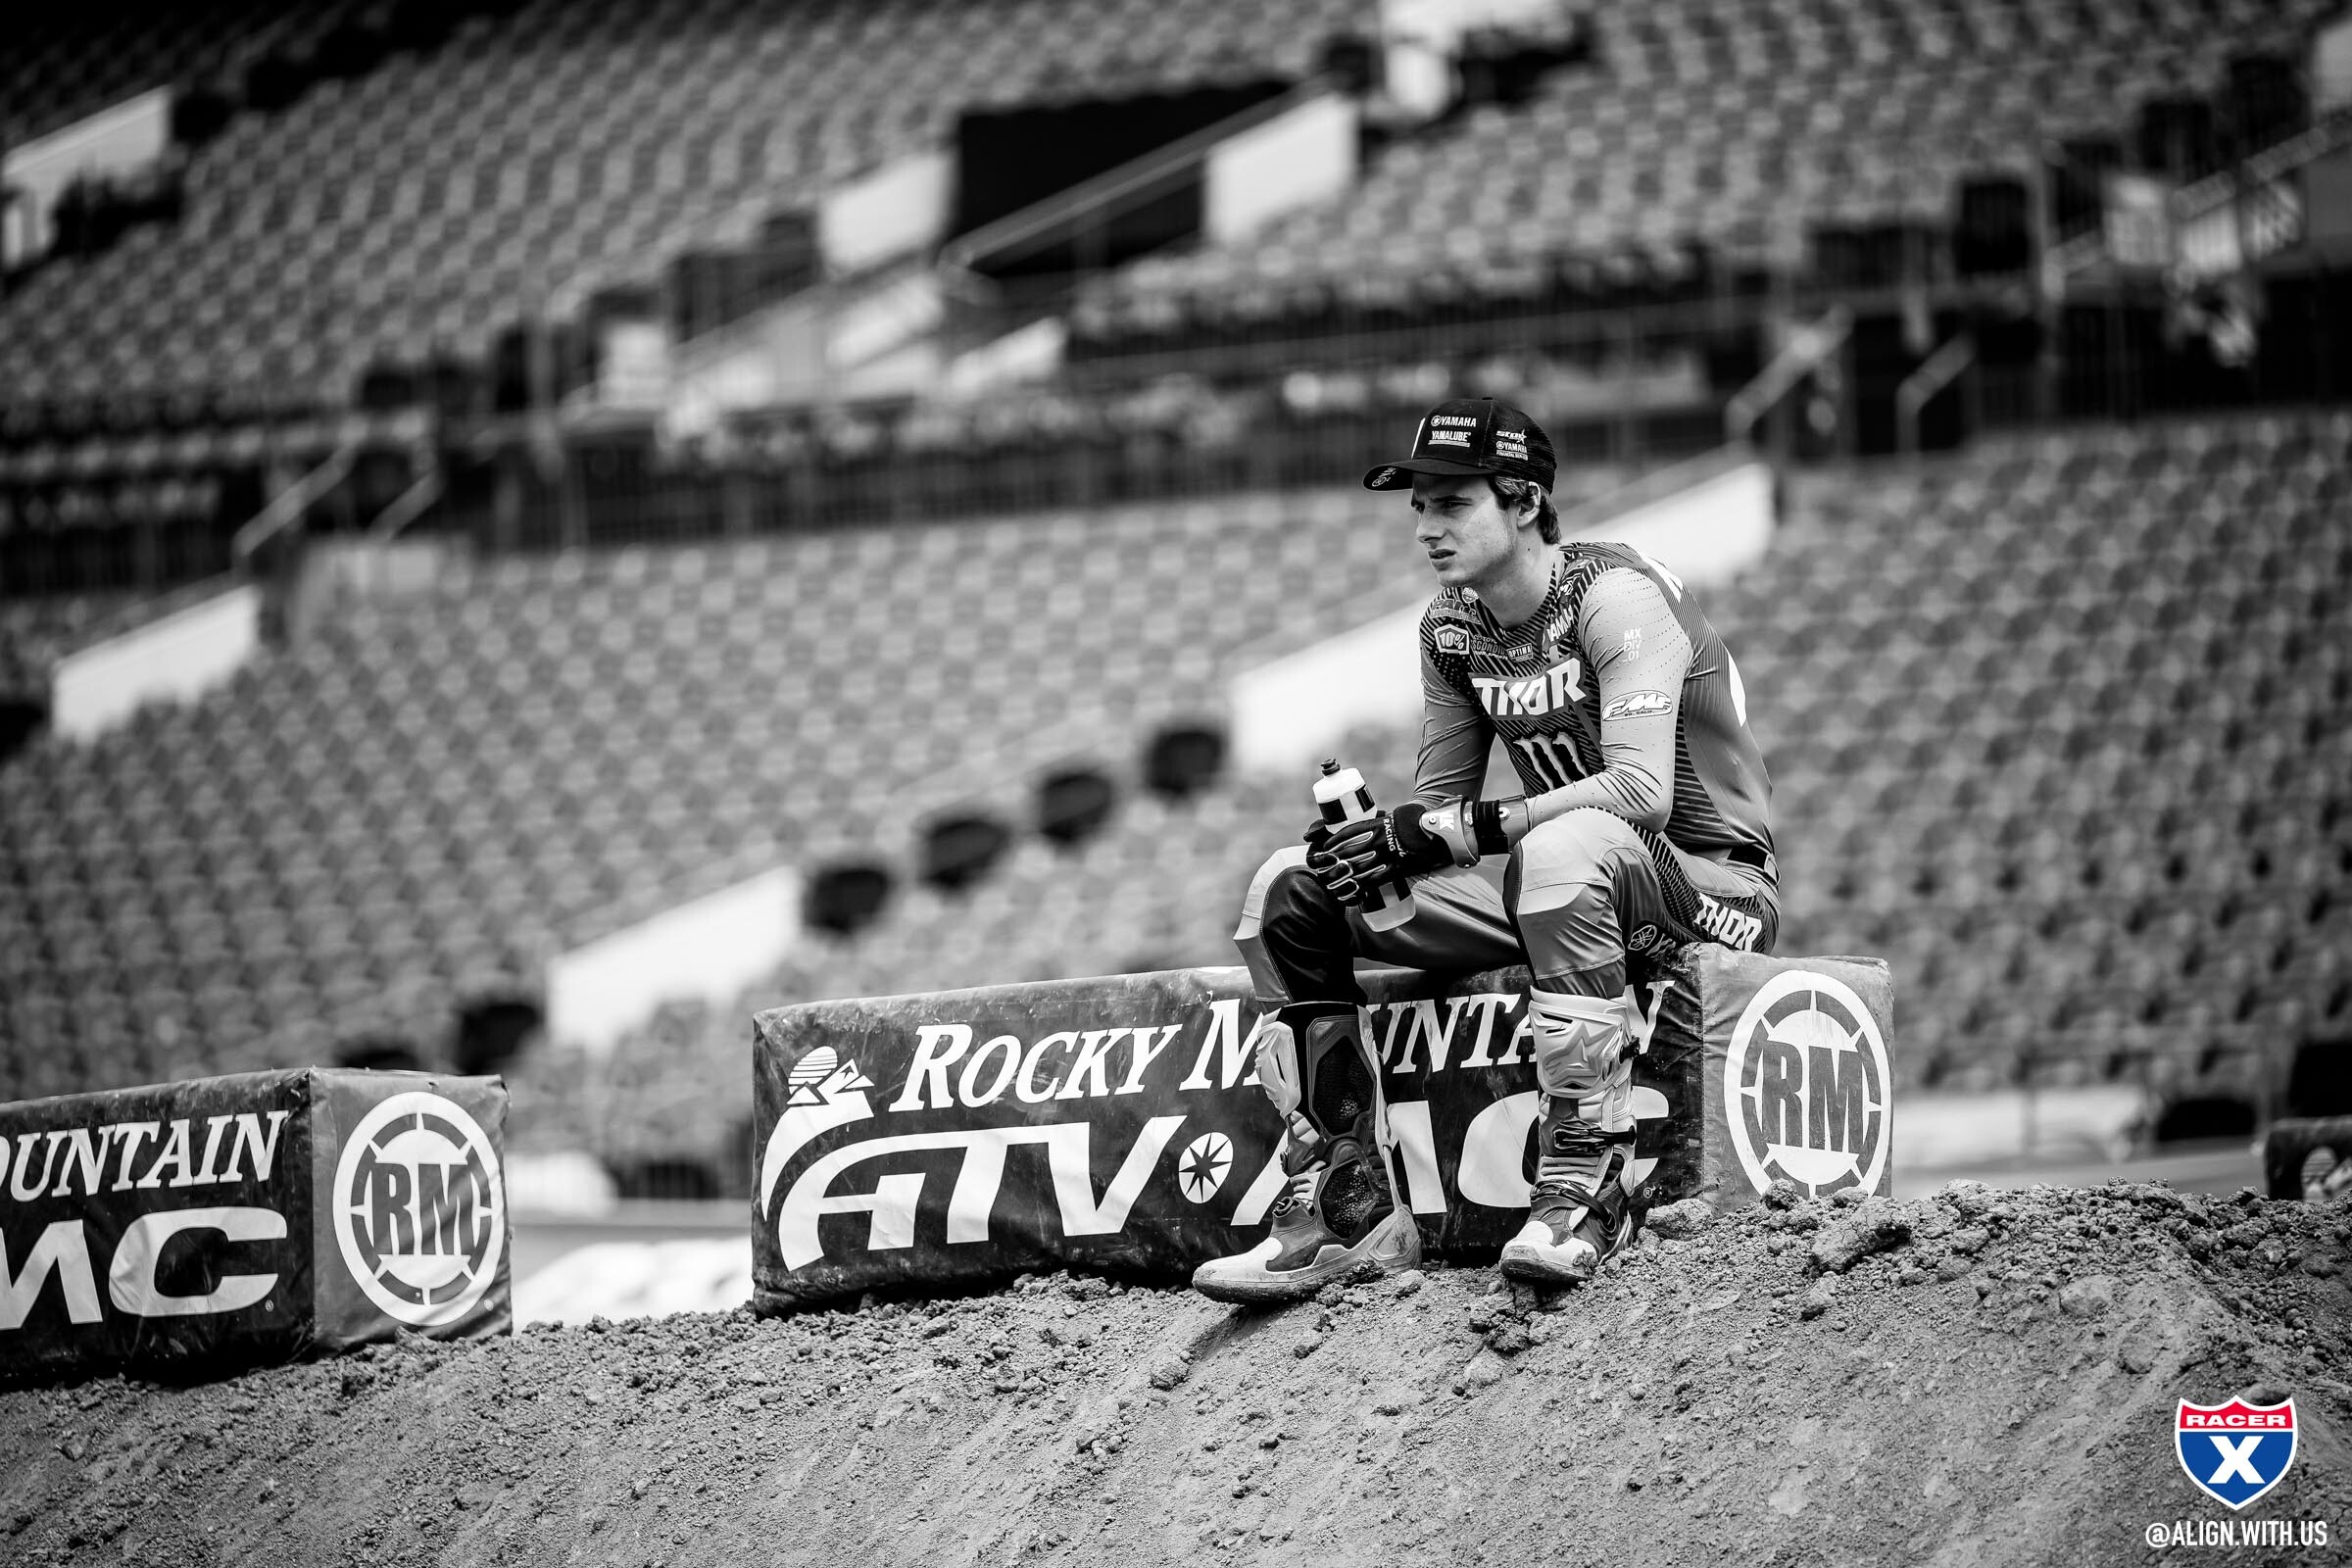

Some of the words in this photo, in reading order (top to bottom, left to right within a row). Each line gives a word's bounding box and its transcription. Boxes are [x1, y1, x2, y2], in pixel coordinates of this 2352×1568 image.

[1432, 430, 1468, 441] YAMALUBE
[1441, 416, 1477, 427] YAMAHA
[1509, 645, 1532, 658] OPTIMA
[1623, 627, 1642, 641] MX
[1471, 658, 1587, 715] THOR
[1383, 818, 1396, 852] RACING
[1693, 893, 1762, 953] THOR
[889, 1022, 1182, 1113] ROCKY
[1763, 1041, 1864, 1154] RM
[0, 1110, 289, 1203] UNTAIN
[370, 1163, 476, 1256] RM
[778, 1114, 1188, 1272] ATV
